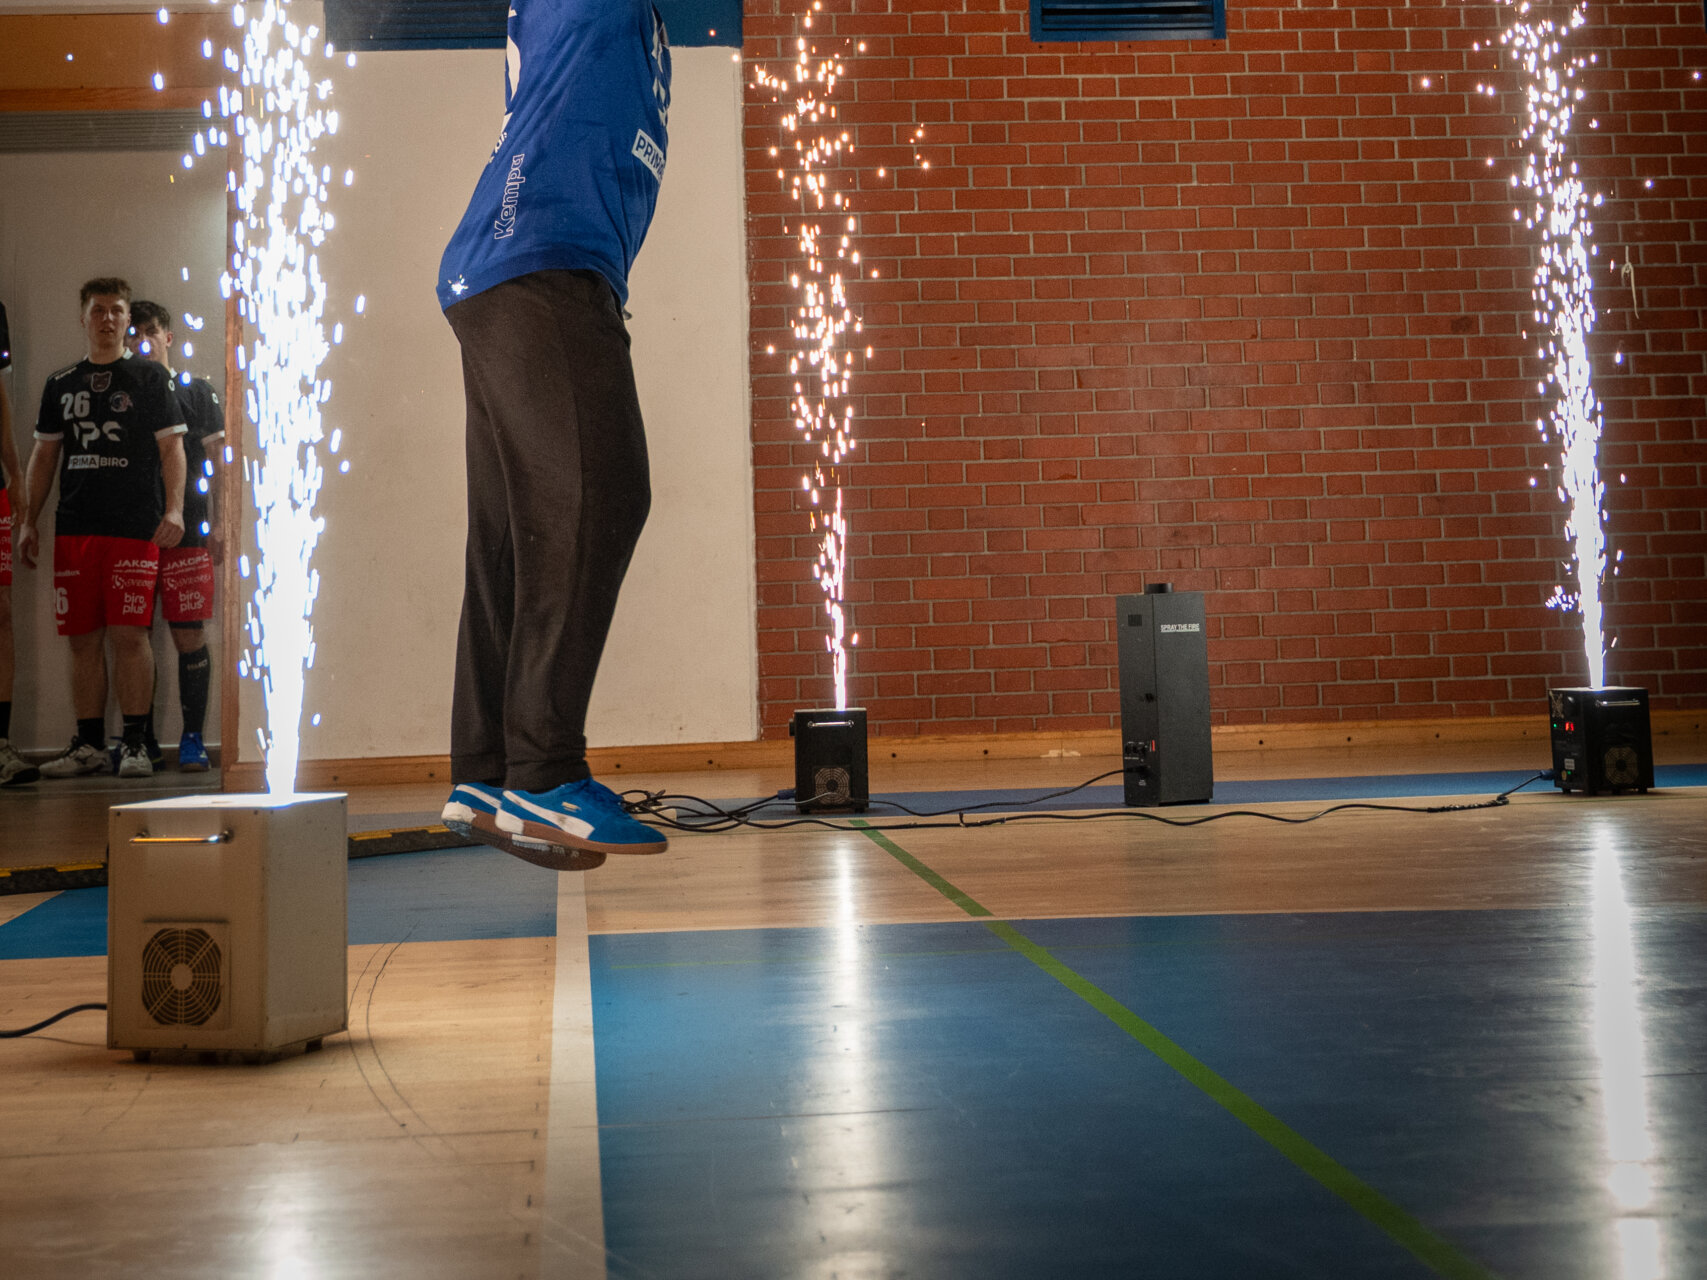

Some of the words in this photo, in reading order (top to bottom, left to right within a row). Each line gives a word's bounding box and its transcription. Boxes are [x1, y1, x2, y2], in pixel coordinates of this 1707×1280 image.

[494, 154, 525, 239] Kempa
[61, 390, 90, 420] 26
[100, 457, 128, 467] BIRO
[124, 592, 145, 603] biro
[179, 590, 201, 601] biro
[122, 604, 145, 615] plus
[180, 601, 203, 613] plus
